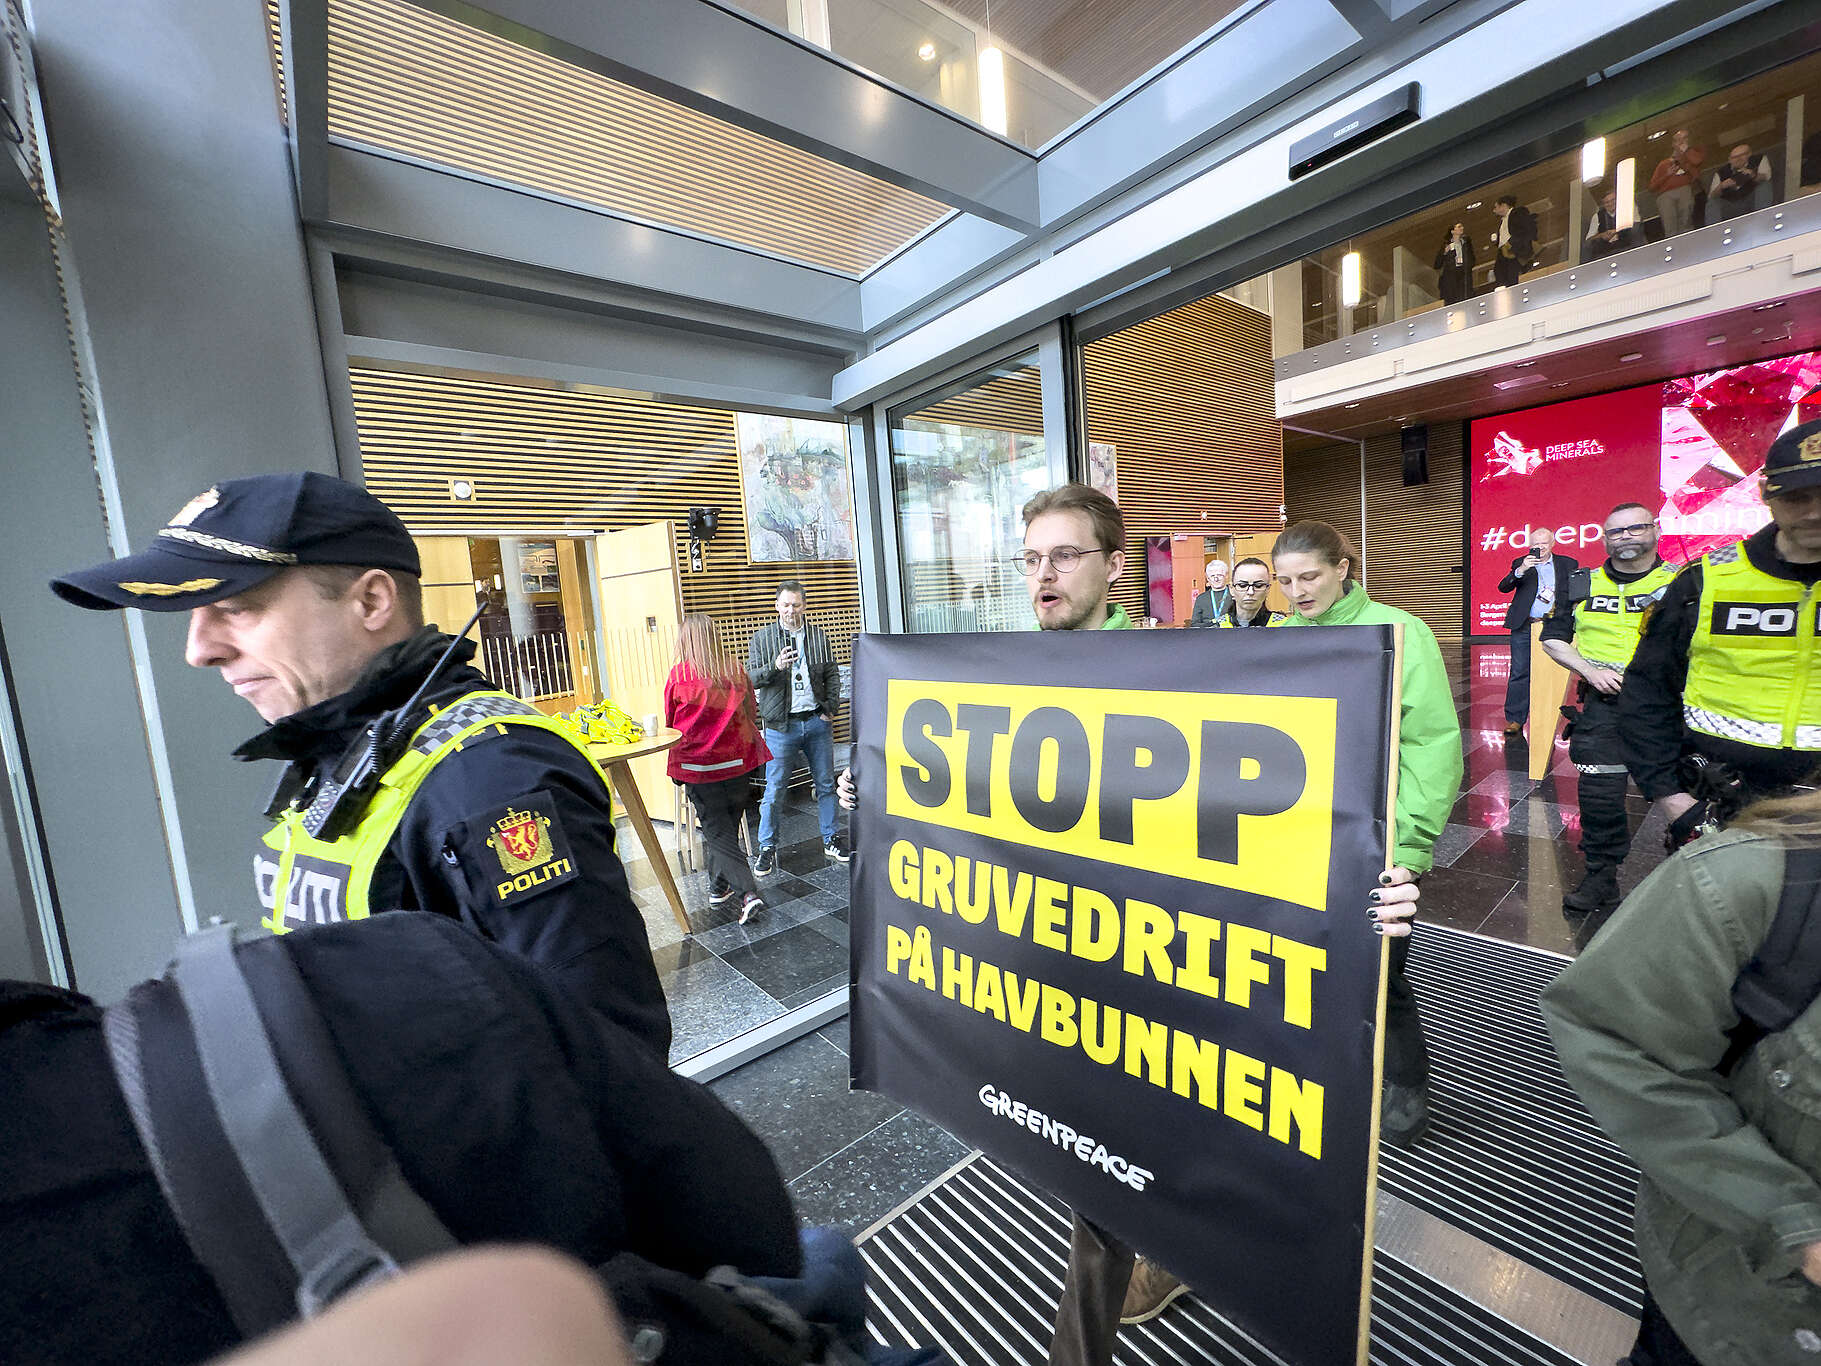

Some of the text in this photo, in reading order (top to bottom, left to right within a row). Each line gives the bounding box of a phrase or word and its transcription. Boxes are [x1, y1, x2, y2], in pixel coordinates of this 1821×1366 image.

[1546, 439, 1599, 454] DEEP SEA
[1546, 445, 1605, 461] MINERALS
[1726, 607, 1821, 632] PO
[900, 698, 1307, 865] STOPP
[497, 858, 573, 900] POLITI
[887, 839, 1327, 1030] GRUVEDRIFT
[886, 924, 1325, 1160] PÅ HAVBUNNEN
[978, 1083, 1155, 1192] GREENPEACE
